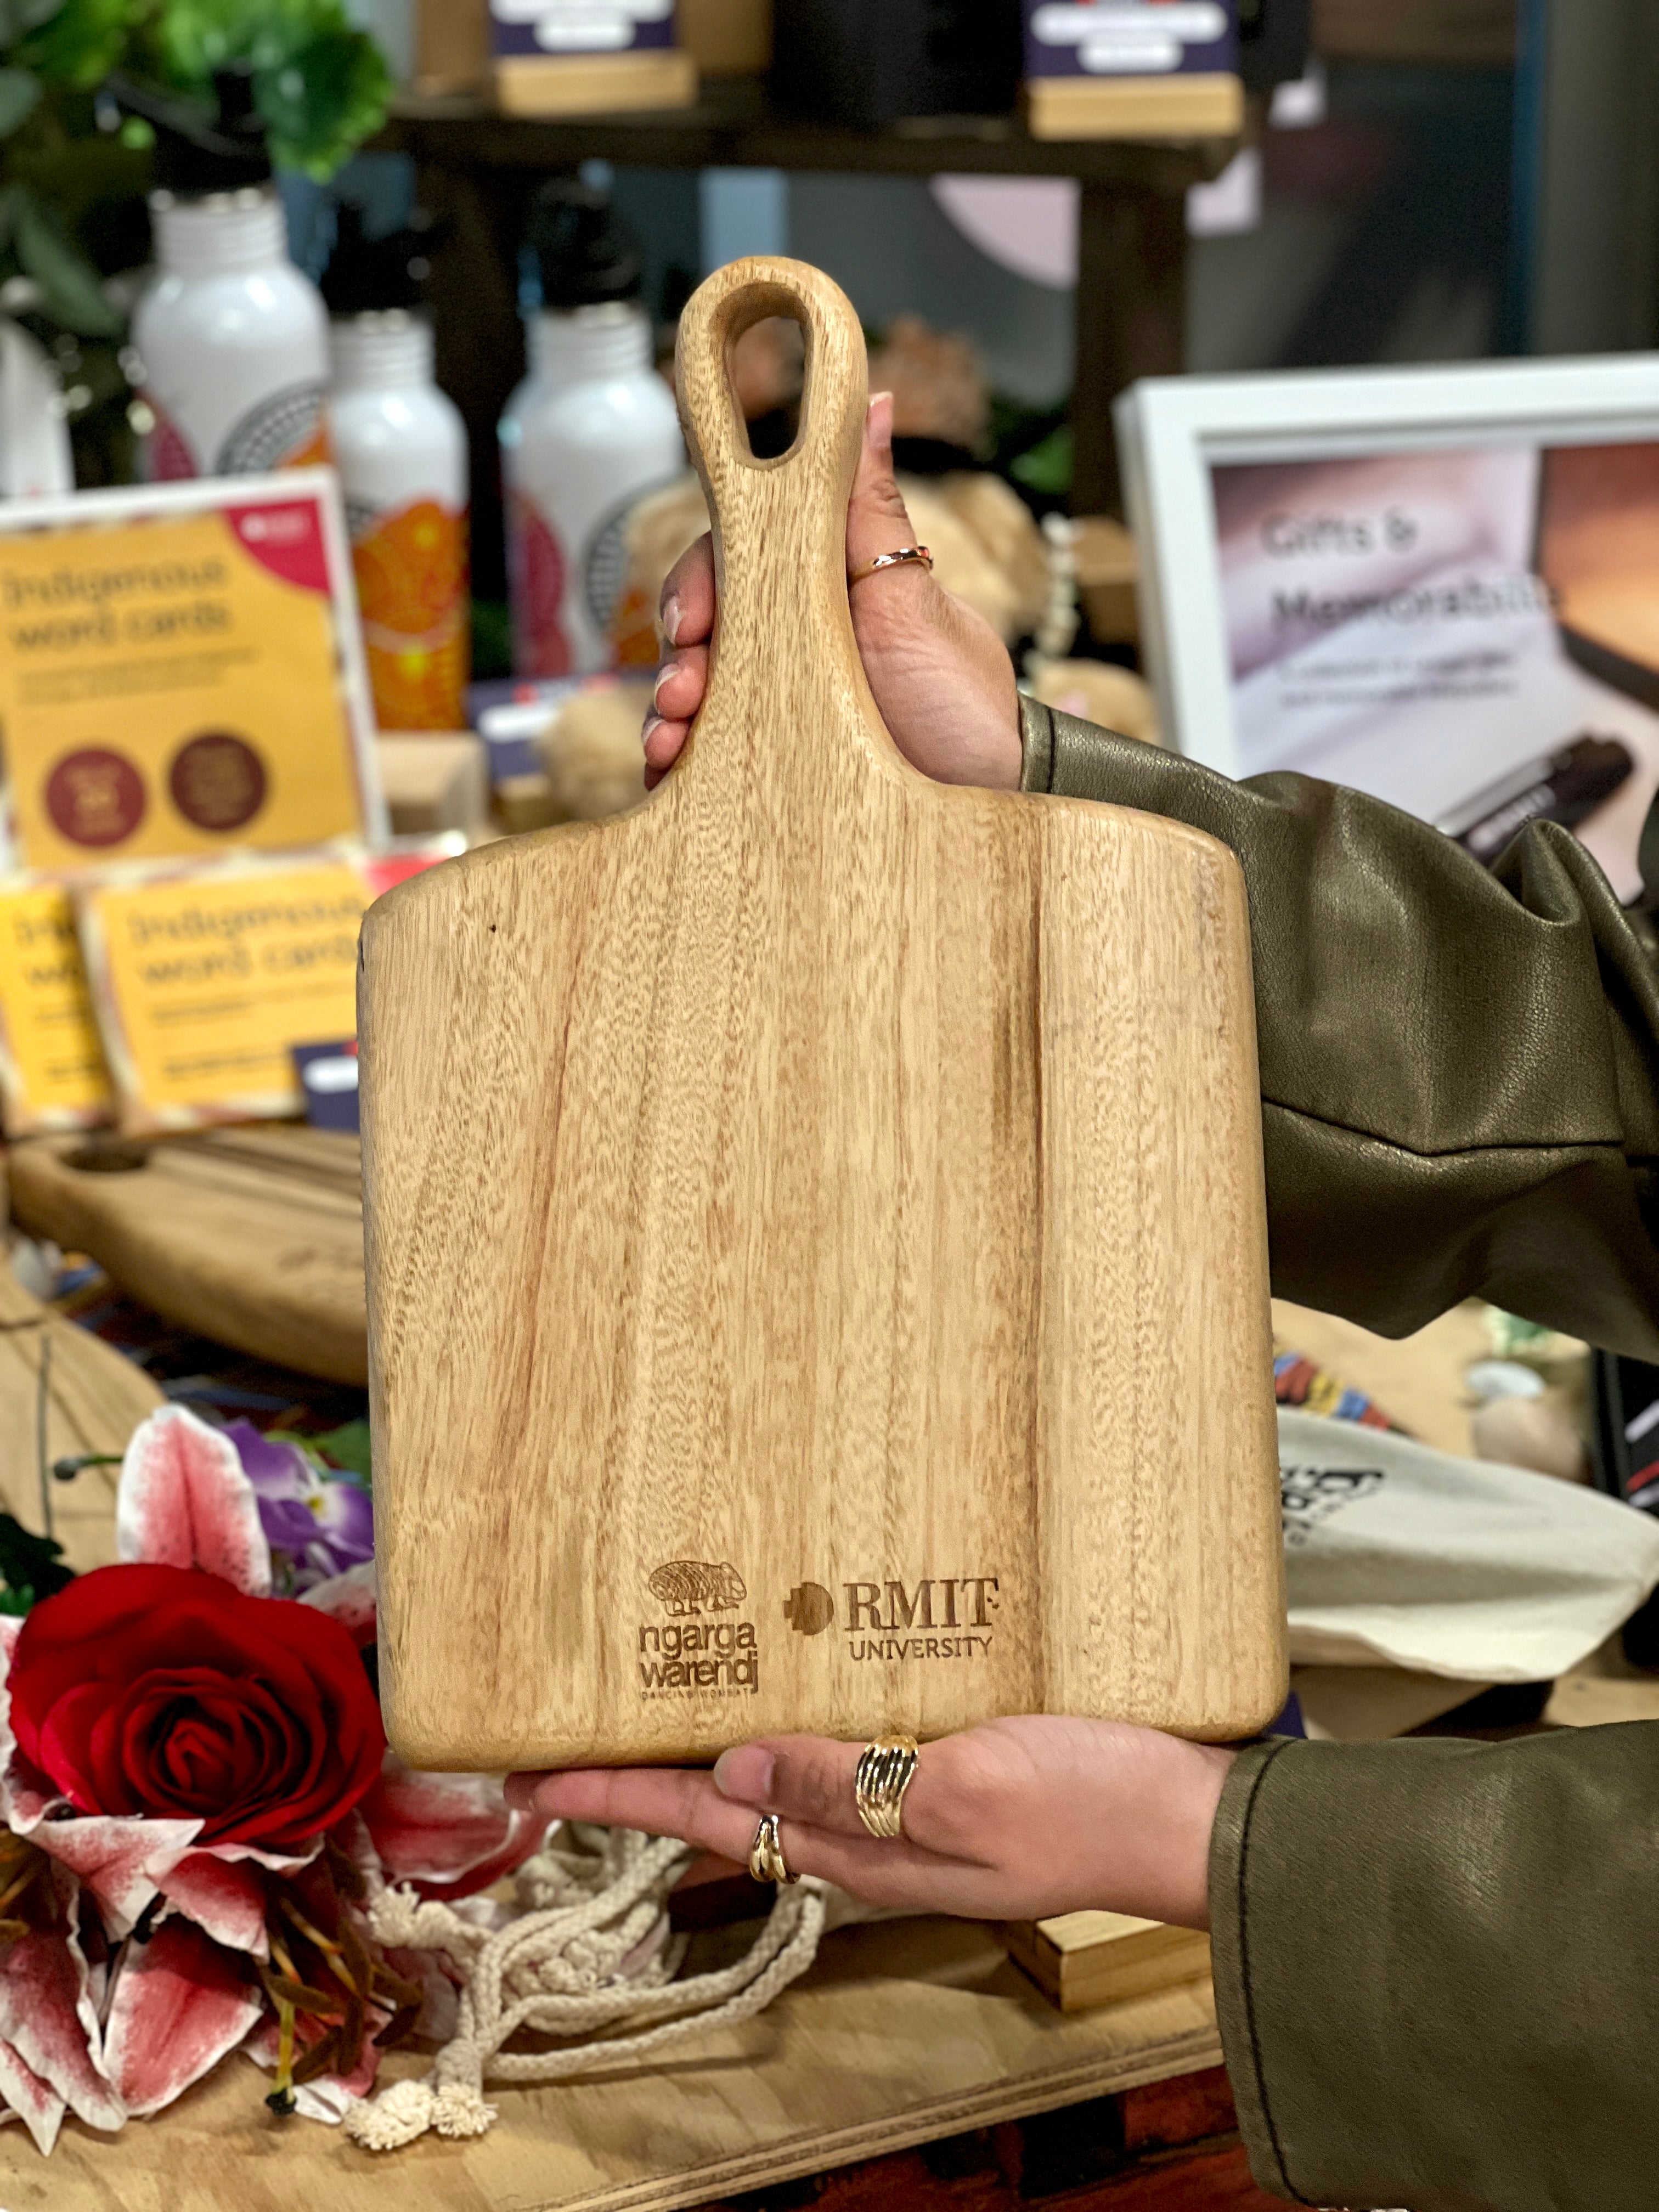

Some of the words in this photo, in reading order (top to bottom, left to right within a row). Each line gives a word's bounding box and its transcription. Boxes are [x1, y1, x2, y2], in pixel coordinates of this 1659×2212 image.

[843, 1578, 1000, 1631] RMIT
[640, 1622, 757, 1660] ngarga
[849, 1636, 992, 1661] UNIVERSITY
[639, 1650, 759, 1694] warendj
